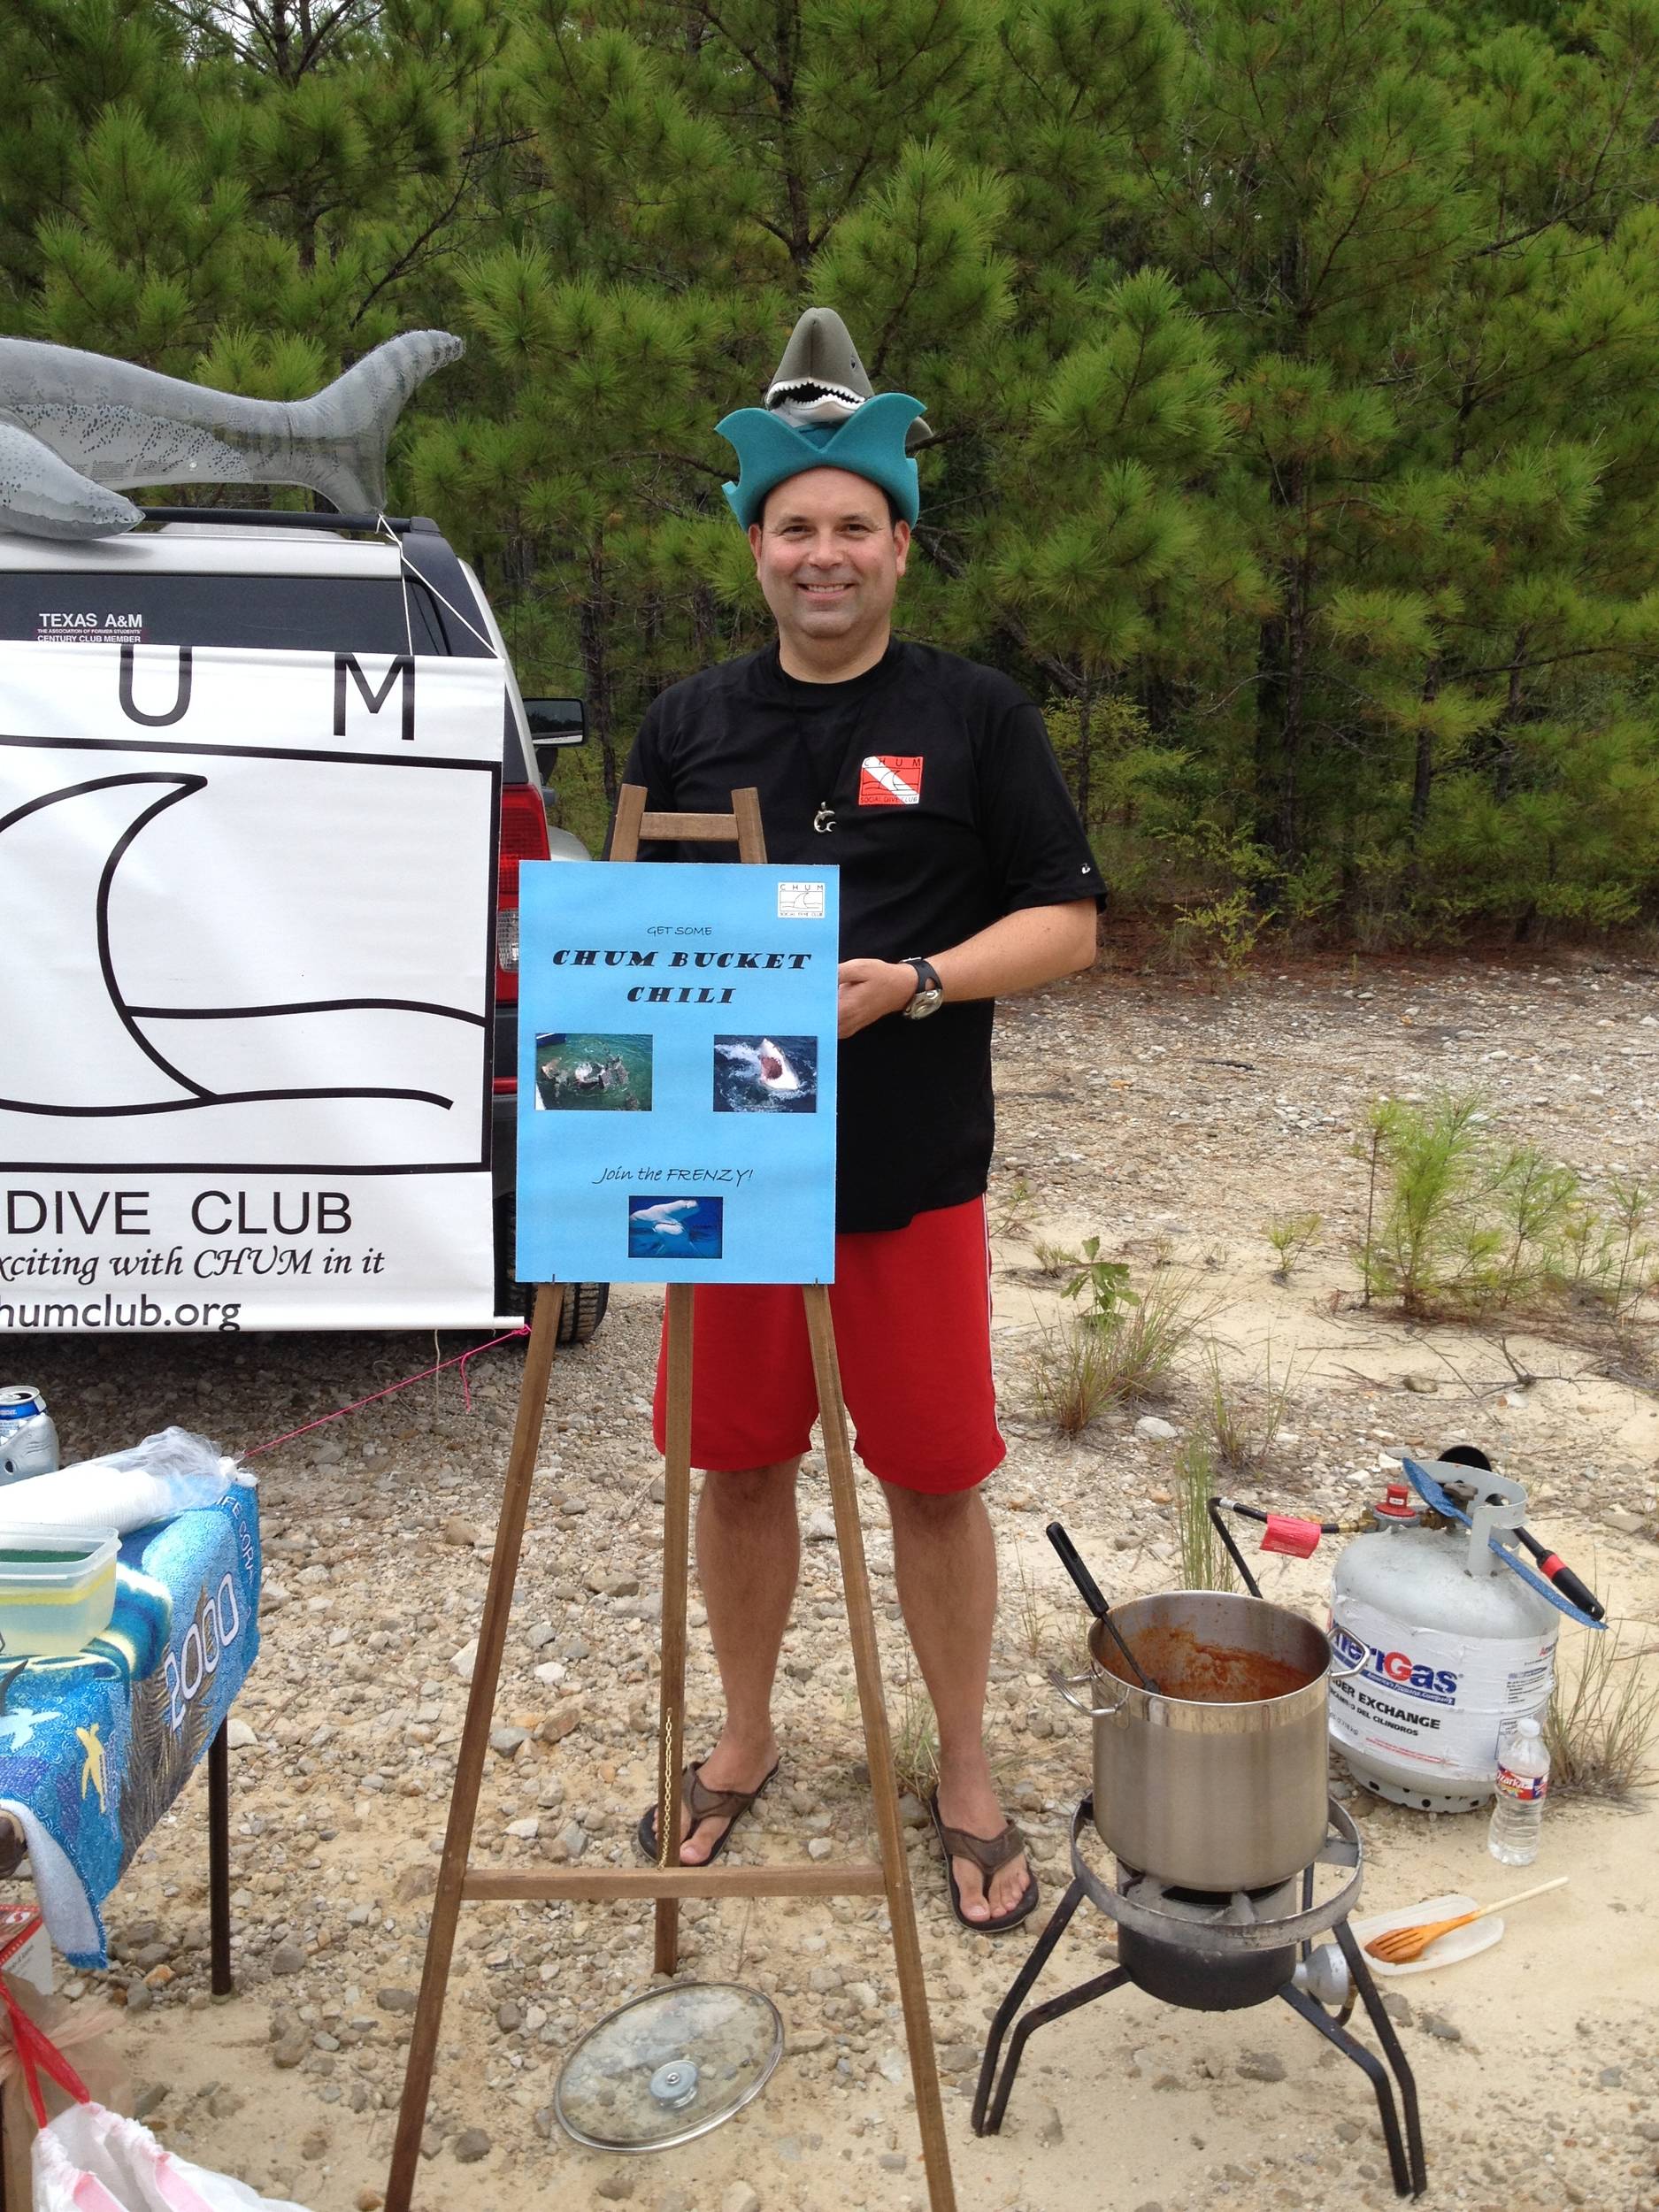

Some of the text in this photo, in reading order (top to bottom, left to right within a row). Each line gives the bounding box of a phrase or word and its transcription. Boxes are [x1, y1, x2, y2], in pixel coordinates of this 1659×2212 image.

[39, 612, 142, 628] TEXAS A&M
[647, 926, 712, 937] GET SOME
[552, 949, 812, 970] CHUM BUCKET
[626, 986, 736, 1004] CHILI
[592, 1165, 754, 1187] Join the FRENZY!
[7, 1190, 352, 1235] DIVE CLUB
[109, 1246, 184, 1276] with
[193, 1245, 314, 1279] CHUM
[323, 1247, 352, 1274] in
[361, 1247, 386, 1274] it
[164, 1571, 240, 1732] 2000
[1356, 1707, 1371, 1720] DEL
[1372, 1715, 1419, 1737] CILINDROS
[1358, 1692, 1441, 1731] EXCHANGE
